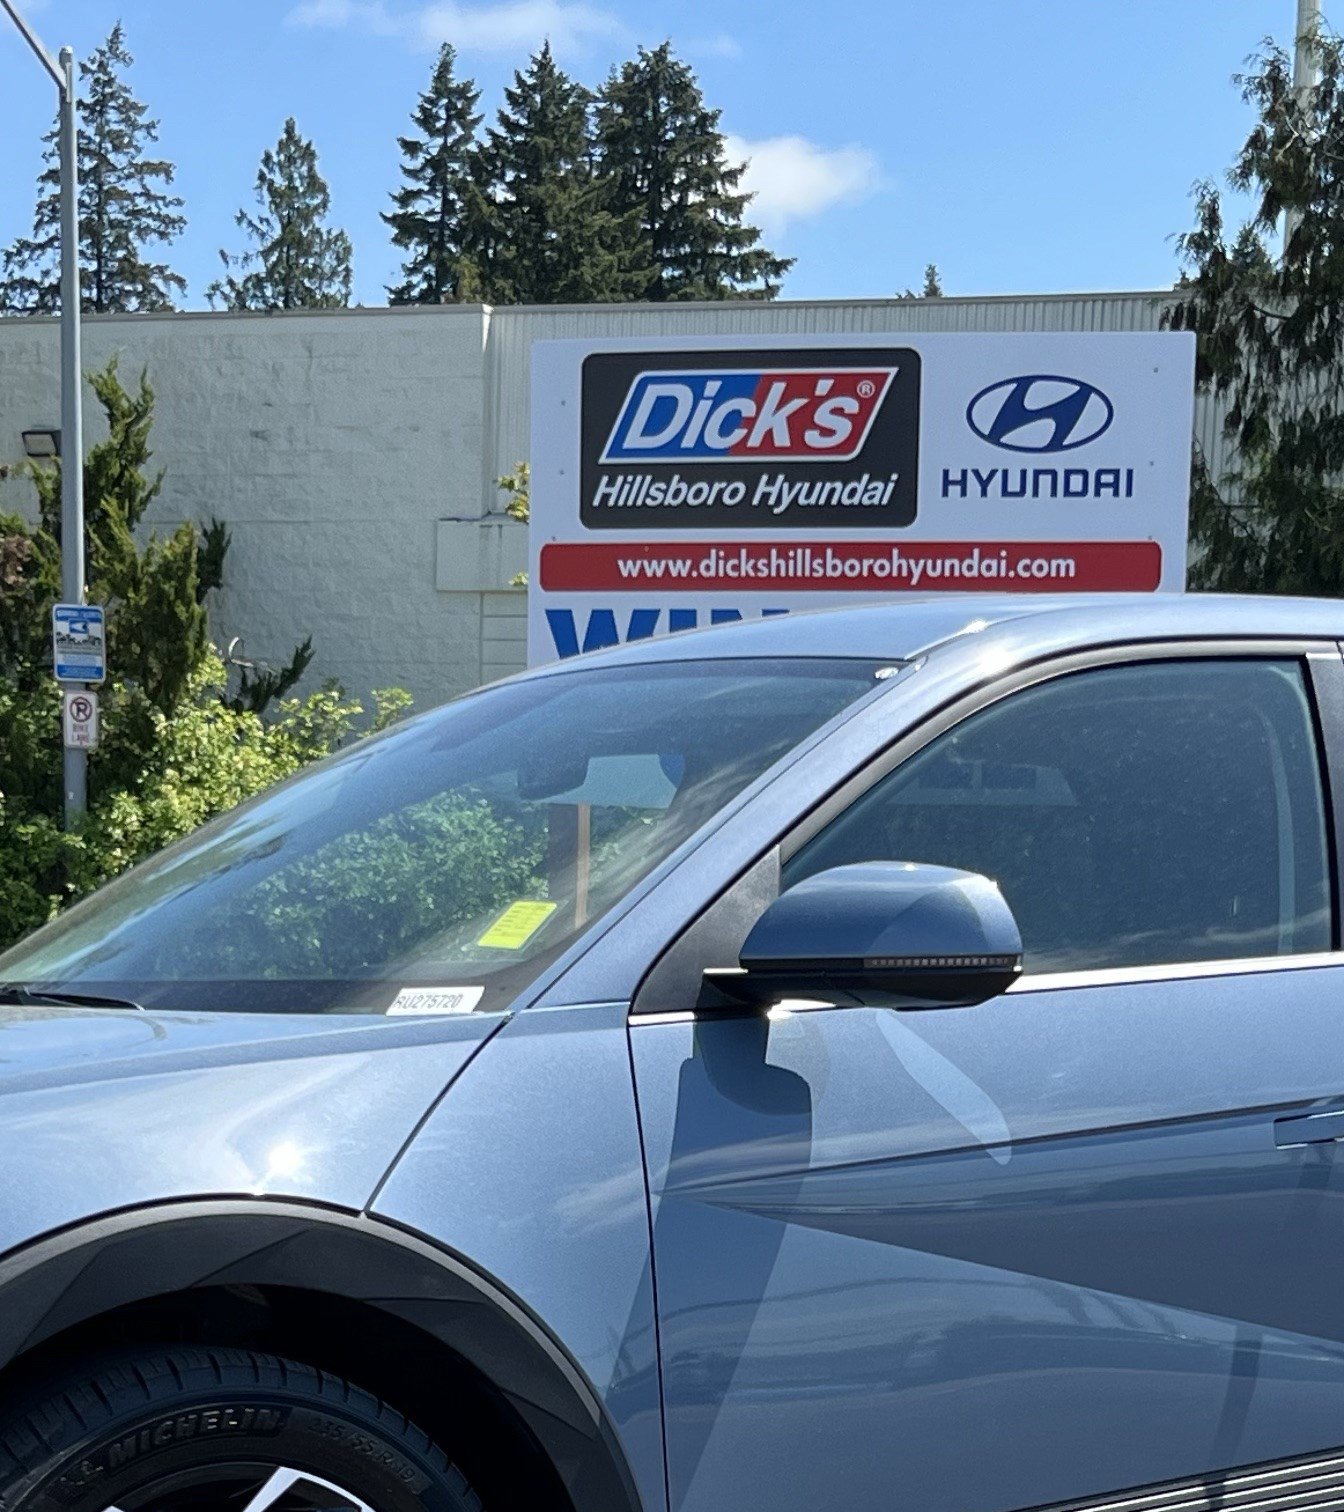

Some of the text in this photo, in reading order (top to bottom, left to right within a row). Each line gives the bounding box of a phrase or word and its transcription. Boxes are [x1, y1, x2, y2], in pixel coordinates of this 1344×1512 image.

[592, 473, 898, 515] Hillsboro Hyundai
[942, 468, 1133, 498] HYUNDAI
[617, 543, 1076, 586] www.dickshillsborohyundai.com
[107, 1408, 283, 1468] MICHELIN
